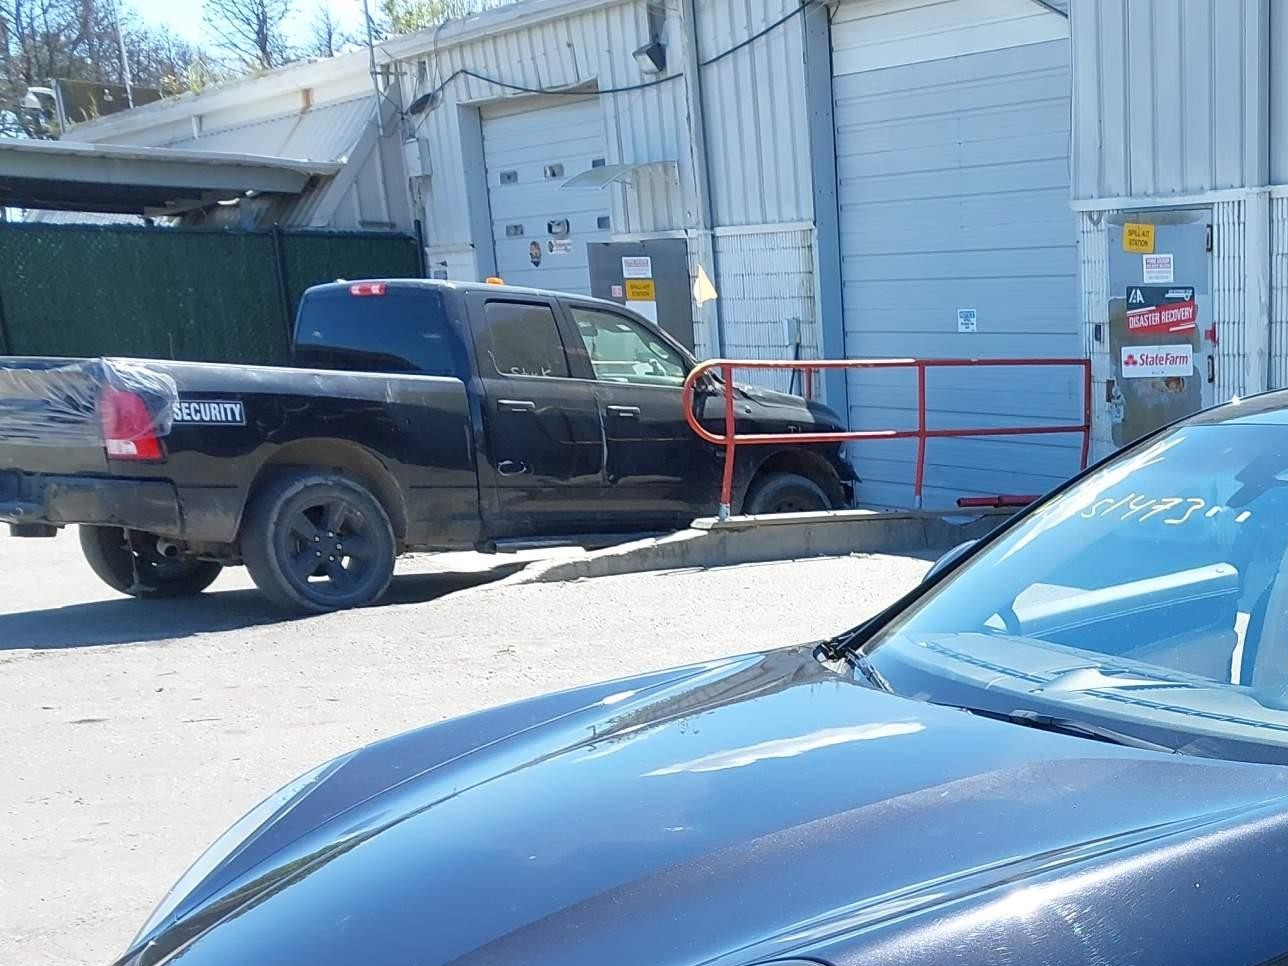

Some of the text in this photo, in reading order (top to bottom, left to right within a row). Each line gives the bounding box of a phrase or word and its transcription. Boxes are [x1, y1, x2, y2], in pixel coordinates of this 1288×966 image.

[1129, 239, 1148, 247] STATION
[1129, 306, 1193, 328] DISASTER RECOVERY
[172, 402, 241, 421] SECURITY
